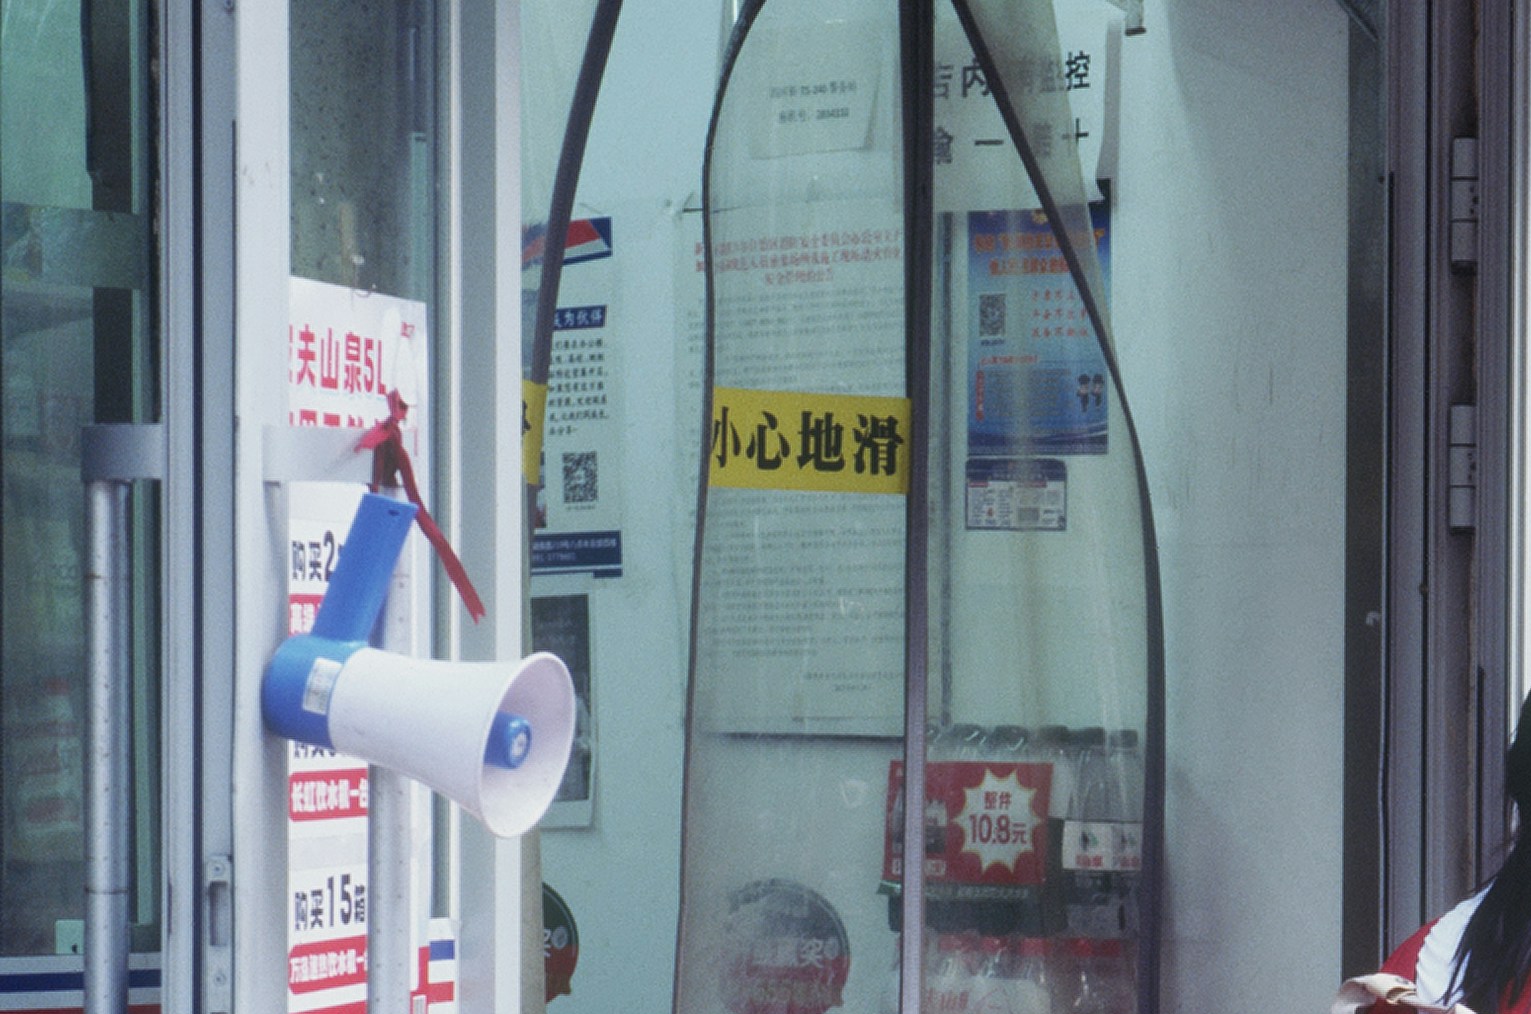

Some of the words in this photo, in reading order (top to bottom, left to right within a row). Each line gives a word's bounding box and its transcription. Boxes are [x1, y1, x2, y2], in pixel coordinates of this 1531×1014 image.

[289, 323, 387, 396] 夫山泉5L
[711, 405, 904, 477] 小心地滑
[292, 529, 347, 581] 购买2
[968, 814, 1028, 846] 10.8元
